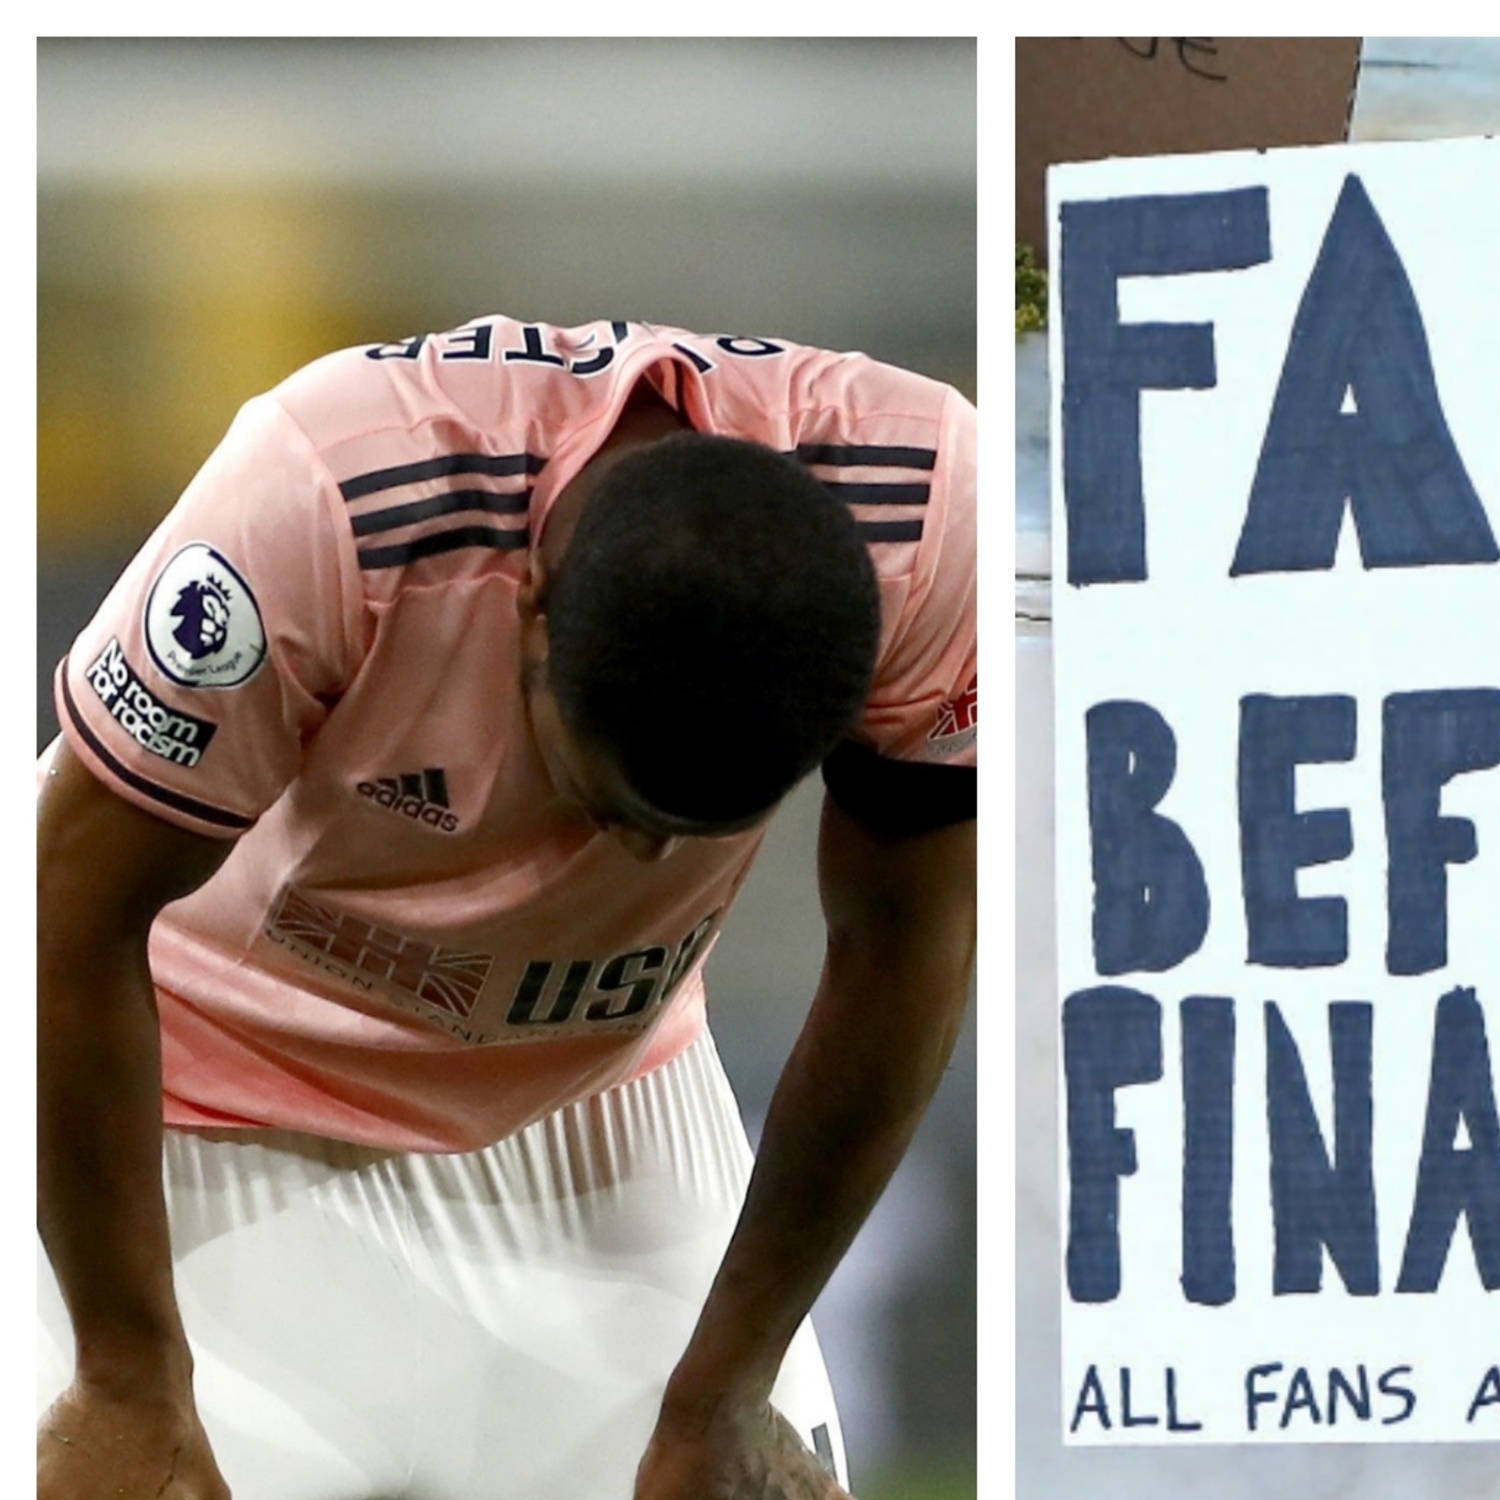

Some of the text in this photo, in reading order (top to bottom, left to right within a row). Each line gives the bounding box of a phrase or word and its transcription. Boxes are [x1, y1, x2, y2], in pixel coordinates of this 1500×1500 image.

[102, 638, 198, 743] No room
[111, 697, 200, 767] racism
[356, 781, 460, 833] adidas
[1070, 1364, 1202, 1432] ALL
[1244, 1362, 1417, 1431] FANS
